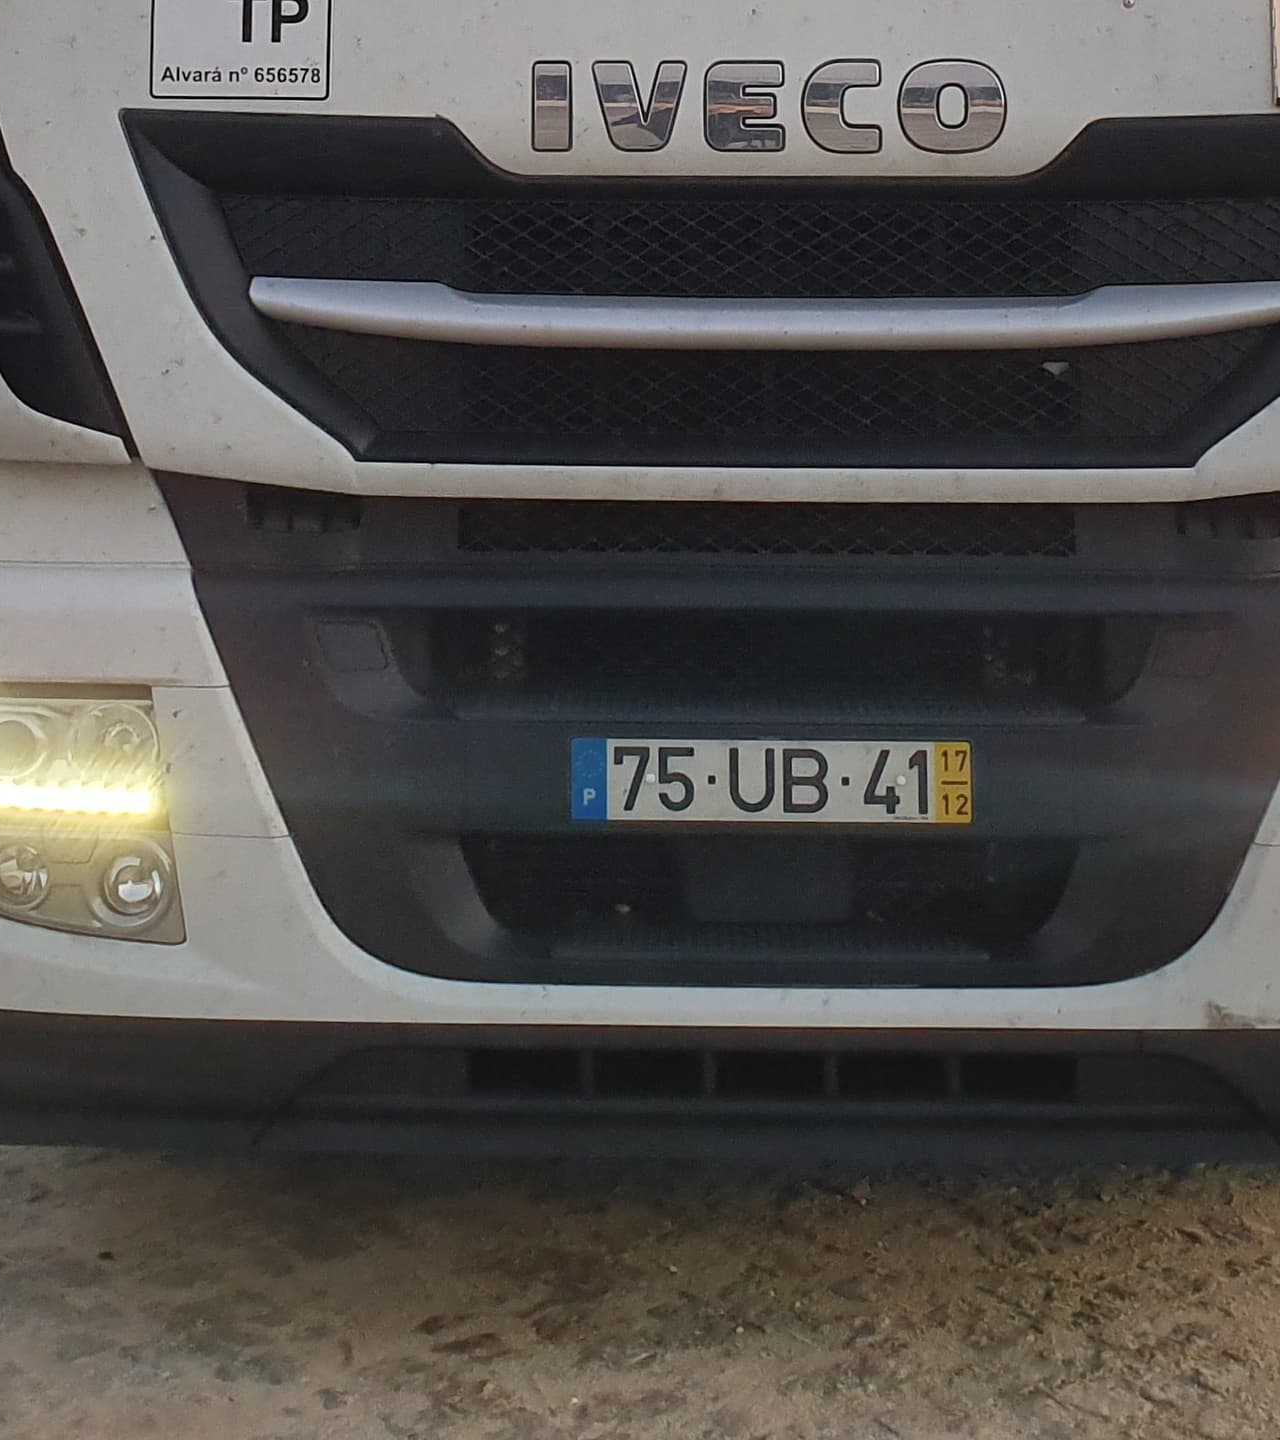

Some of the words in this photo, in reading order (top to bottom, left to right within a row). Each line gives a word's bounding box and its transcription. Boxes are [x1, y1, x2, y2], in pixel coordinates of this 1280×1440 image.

[161, 66, 222, 83] Alvará
[228, 67, 248, 82] nº
[254, 67, 321, 83] 656578
[530, 57, 1008, 154] IVECO
[940, 750, 968, 773] 17
[582, 788, 597, 806] P
[941, 793, 969, 816] 12
